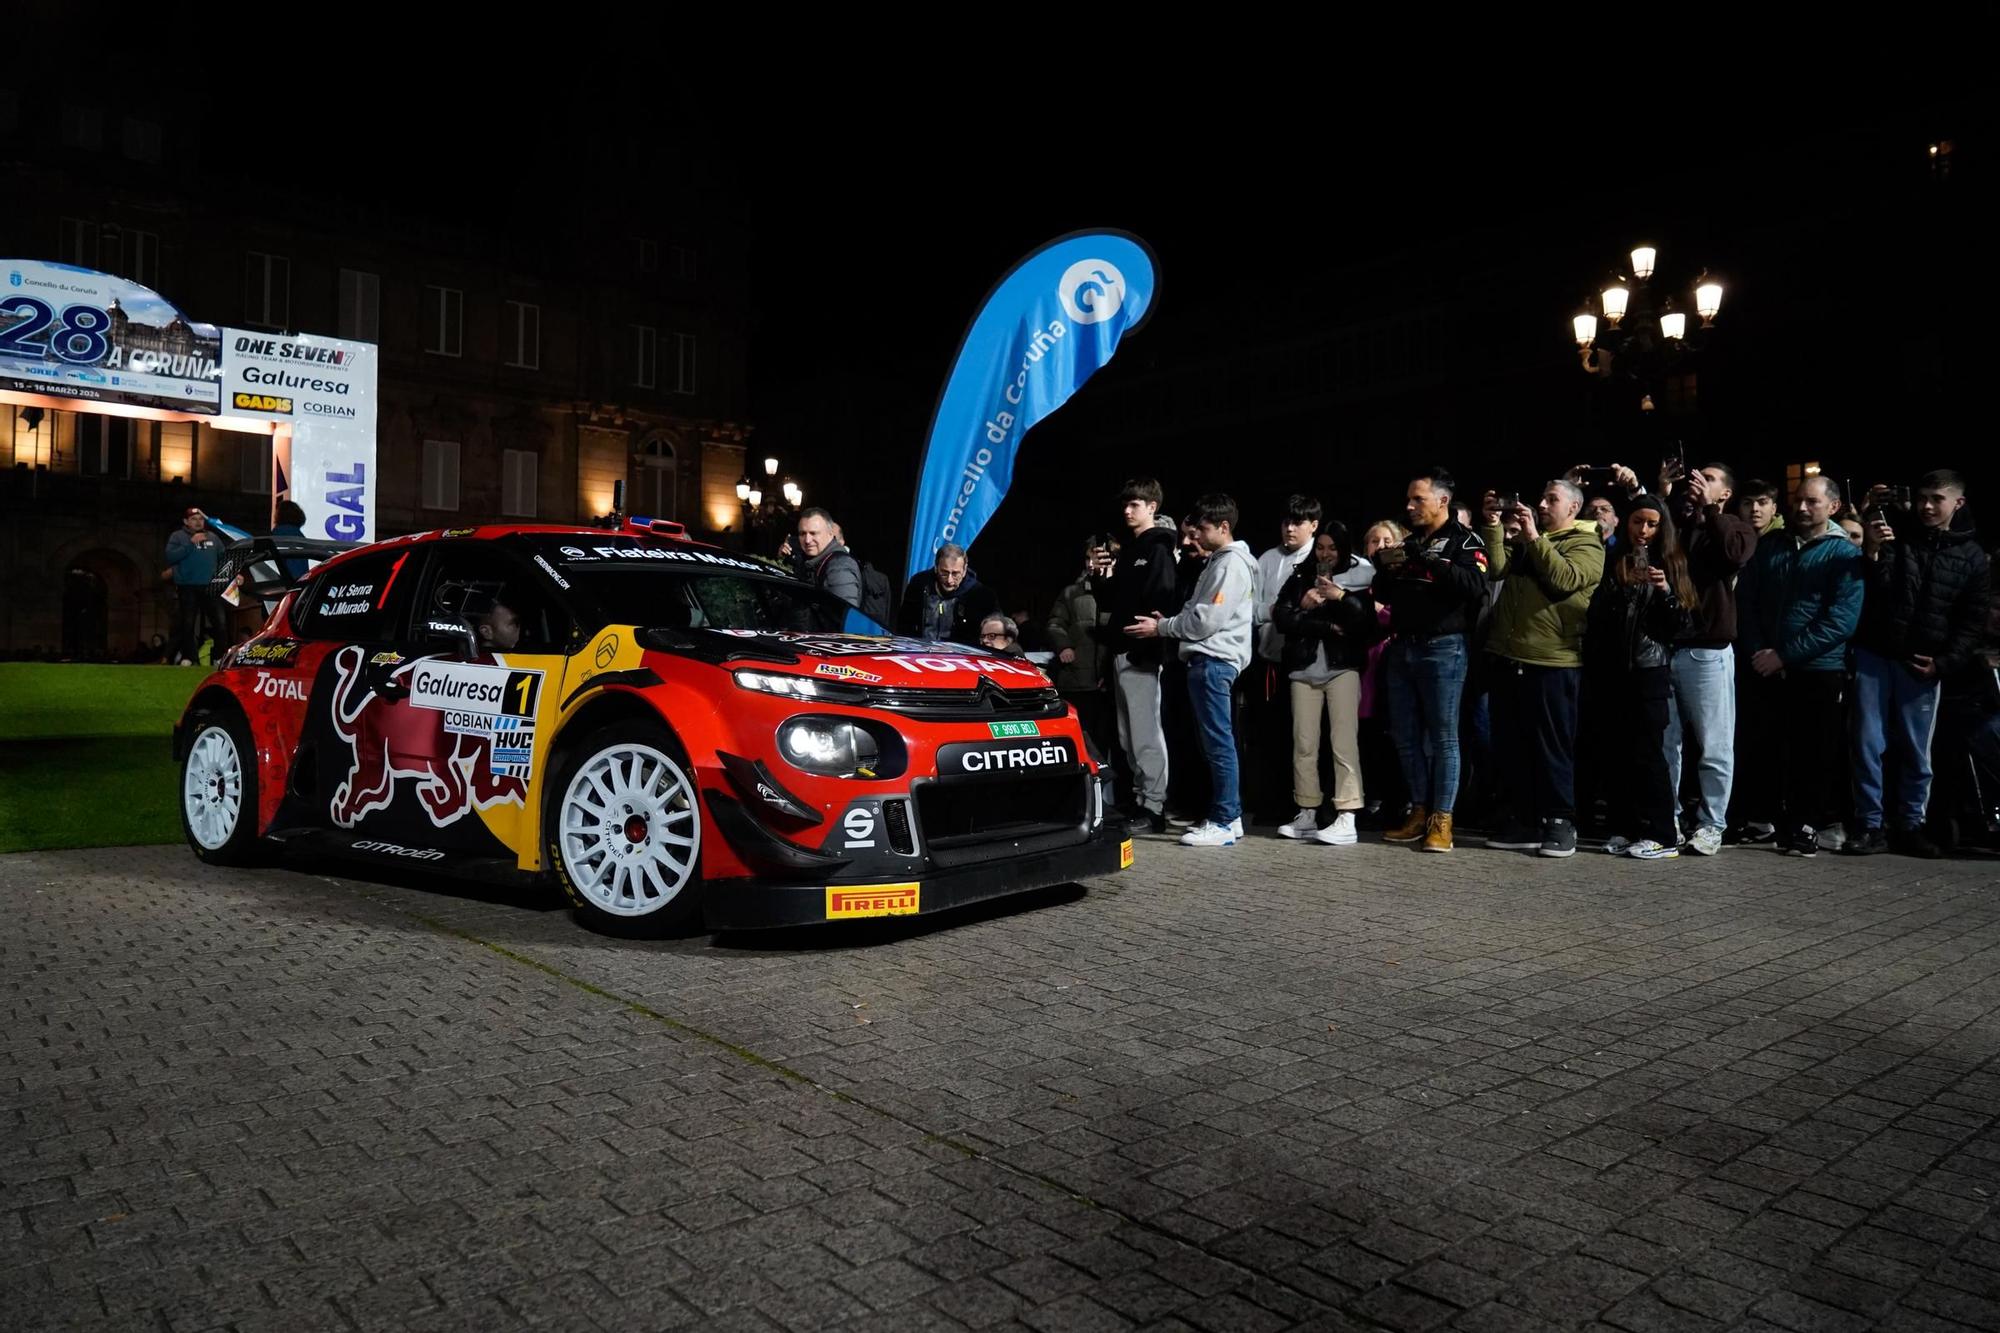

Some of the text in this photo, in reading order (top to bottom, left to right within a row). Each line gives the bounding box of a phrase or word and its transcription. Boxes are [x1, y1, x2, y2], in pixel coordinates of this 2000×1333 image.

[24, 278, 58, 290] Concello
[70, 285, 98, 296] Coruña
[0, 296, 111, 363] 28
[234, 336, 276, 356] ONE
[106, 345, 217, 380] A CORUÑA
[242, 366, 350, 395] Galuresa
[986, 411, 1015, 444] da
[1006, 319, 1067, 405] Coruña
[46, 385, 78, 396] MARZO
[79, 388, 100, 398] 2024
[235, 394, 292, 413] GADIS
[303, 402, 356, 417] COBIAN
[325, 463, 366, 542] GAL
[377, 551, 410, 609] 1
[337, 584, 374, 598] V. Senra
[428, 621, 467, 633] TOTAL
[819, 664, 883, 682] Rallycar
[872, 655, 1037, 677] TOTAL
[253, 671, 308, 701] TOTAL
[416, 671, 533, 715] Galuresa 1
[445, 711, 493, 731] COBIAN
[992, 724, 999, 736] P
[495, 731, 534, 749] HVC
[962, 741, 1068, 772] CITROËN
[831, 889, 916, 912] PIRELLI
